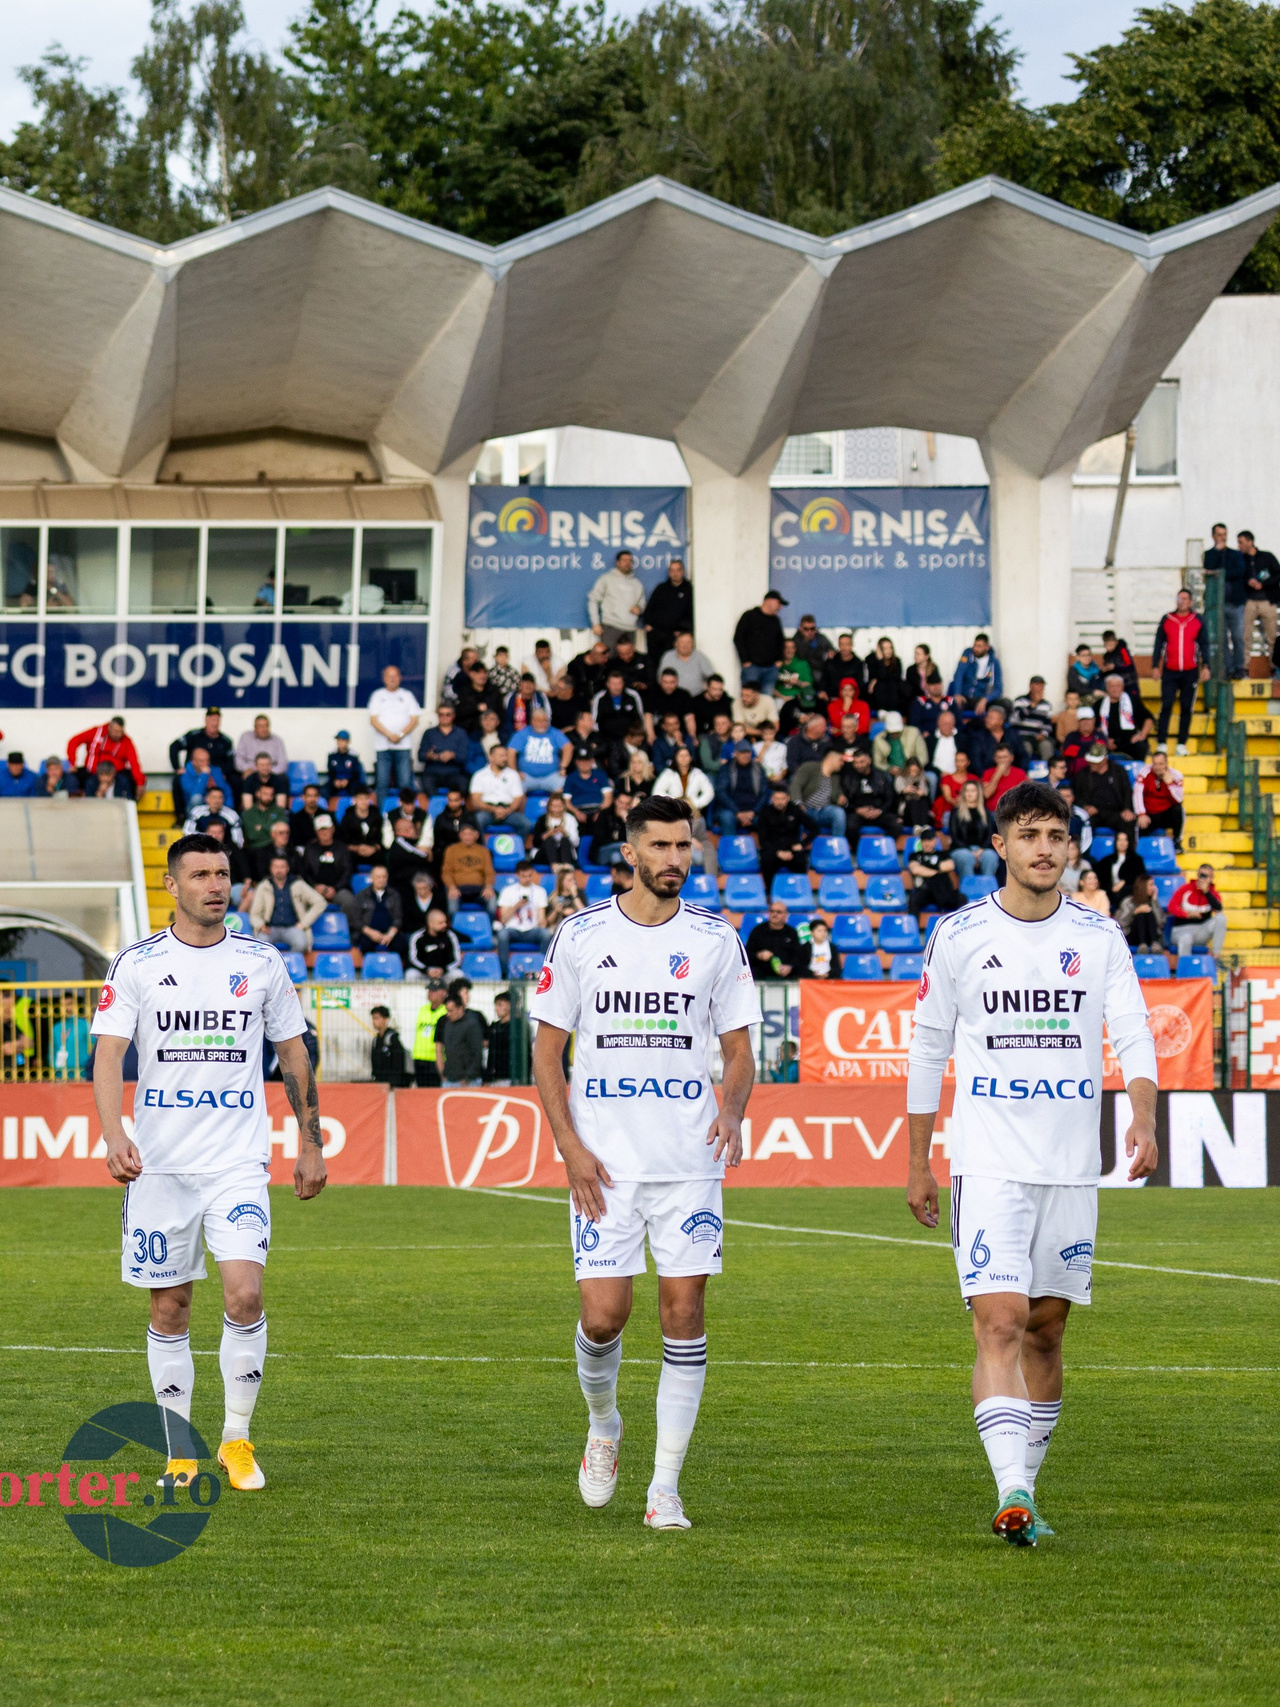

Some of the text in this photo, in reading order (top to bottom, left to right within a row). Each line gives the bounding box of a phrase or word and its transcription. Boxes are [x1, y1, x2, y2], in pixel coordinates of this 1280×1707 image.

[470, 552, 582, 573] aquapark
[591, 551, 606, 570] &
[772, 550, 986, 572] aquapark & sports
[64, 643, 359, 698] BOTOȘANI
[595, 991, 696, 1016] UNIBET
[983, 989, 1087, 1014] UNIBET
[156, 1010, 252, 1031] UNIBET
[650, 1036, 673, 1048] SPRE
[673, 1037, 686, 1049] 0%
[1040, 1035, 1063, 1048] SPRE
[1064, 1035, 1080, 1048] 0%
[207, 1050, 230, 1062] SPRE
[230, 1052, 243, 1062] 0%
[824, 1060, 863, 1078] APA
[585, 1077, 702, 1100] ELSACO
[971, 1075, 1095, 1100] ELSACO
[144, 1088, 254, 1109] ELSACO
[229, 1207, 240, 1220] FIVE
[575, 1214, 600, 1253] 16
[683, 1219, 696, 1235] FIVE
[133, 1228, 168, 1265] 30
[970, 1229, 991, 1269] 6
[1062, 1247, 1076, 1259] FIVE
[588, 1257, 617, 1267] Vestra
[149, 1269, 178, 1279] Vestra
[989, 1272, 1019, 1283] Vestra
